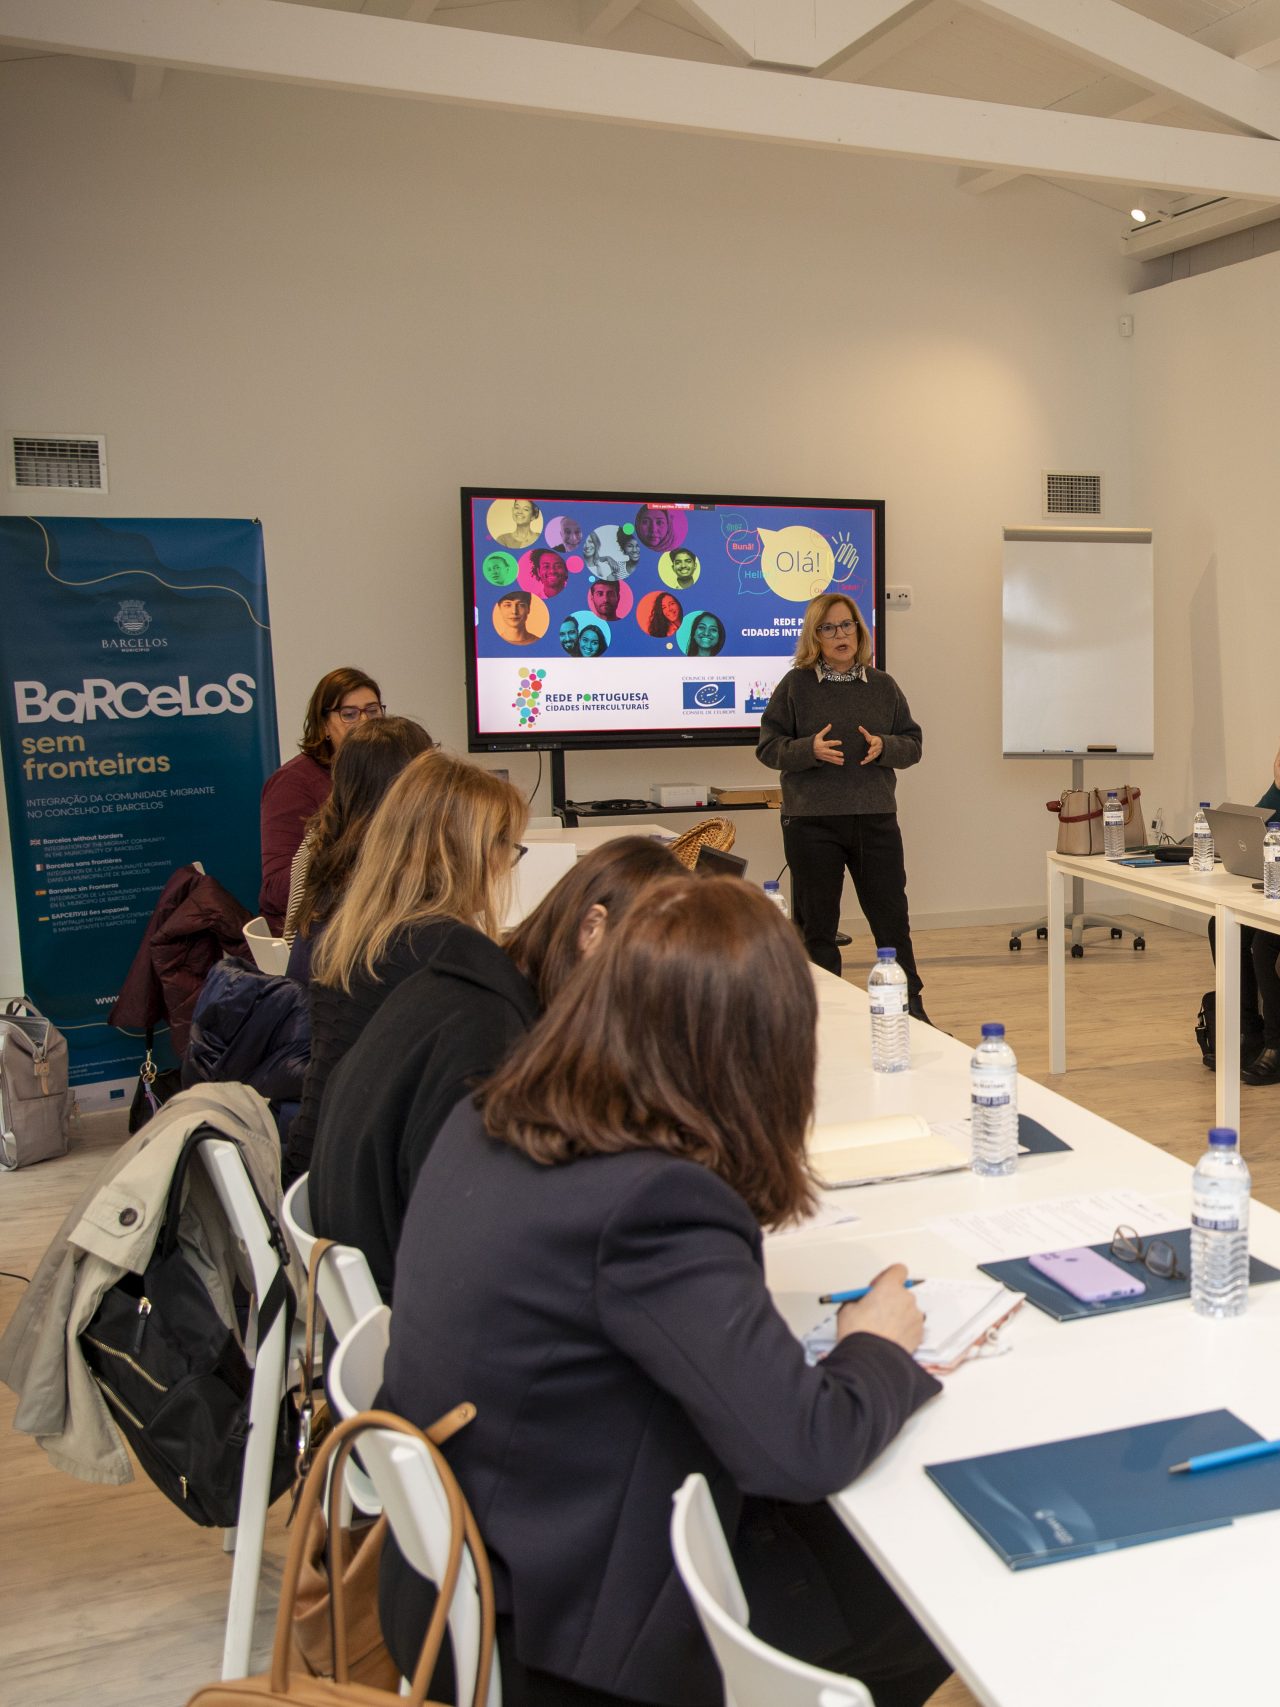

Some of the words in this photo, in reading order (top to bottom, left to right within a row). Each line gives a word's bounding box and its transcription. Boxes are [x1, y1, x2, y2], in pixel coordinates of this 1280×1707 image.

[776, 550, 820, 573] Olá!
[744, 570, 770, 579] Hell
[773, 618, 796, 626] REDE
[741, 629, 780, 637] CIDADES
[102, 639, 168, 648] BARCELOS
[546, 694, 572, 702] REDE
[576, 693, 649, 702] PORTUGUESA
[546, 703, 580, 711] CIDADES
[582, 702, 649, 711] INTERCULTURAIS
[22, 735, 85, 755] sem
[23, 753, 170, 781] fronteiras
[26, 795, 88, 807] INTEGRAÇÃO
[90, 794, 103, 802] DA
[105, 790, 168, 802] COMUNIDADE
[170, 786, 216, 797] MIGRANTE
[27, 810, 42, 819] NO
[45, 806, 100, 817] CONCELHO
[101, 804, 114, 813] DE
[117, 801, 164, 812] BARCELOS
[46, 862, 74, 870] Barcelos
[48, 887, 77, 895] Barcelos
